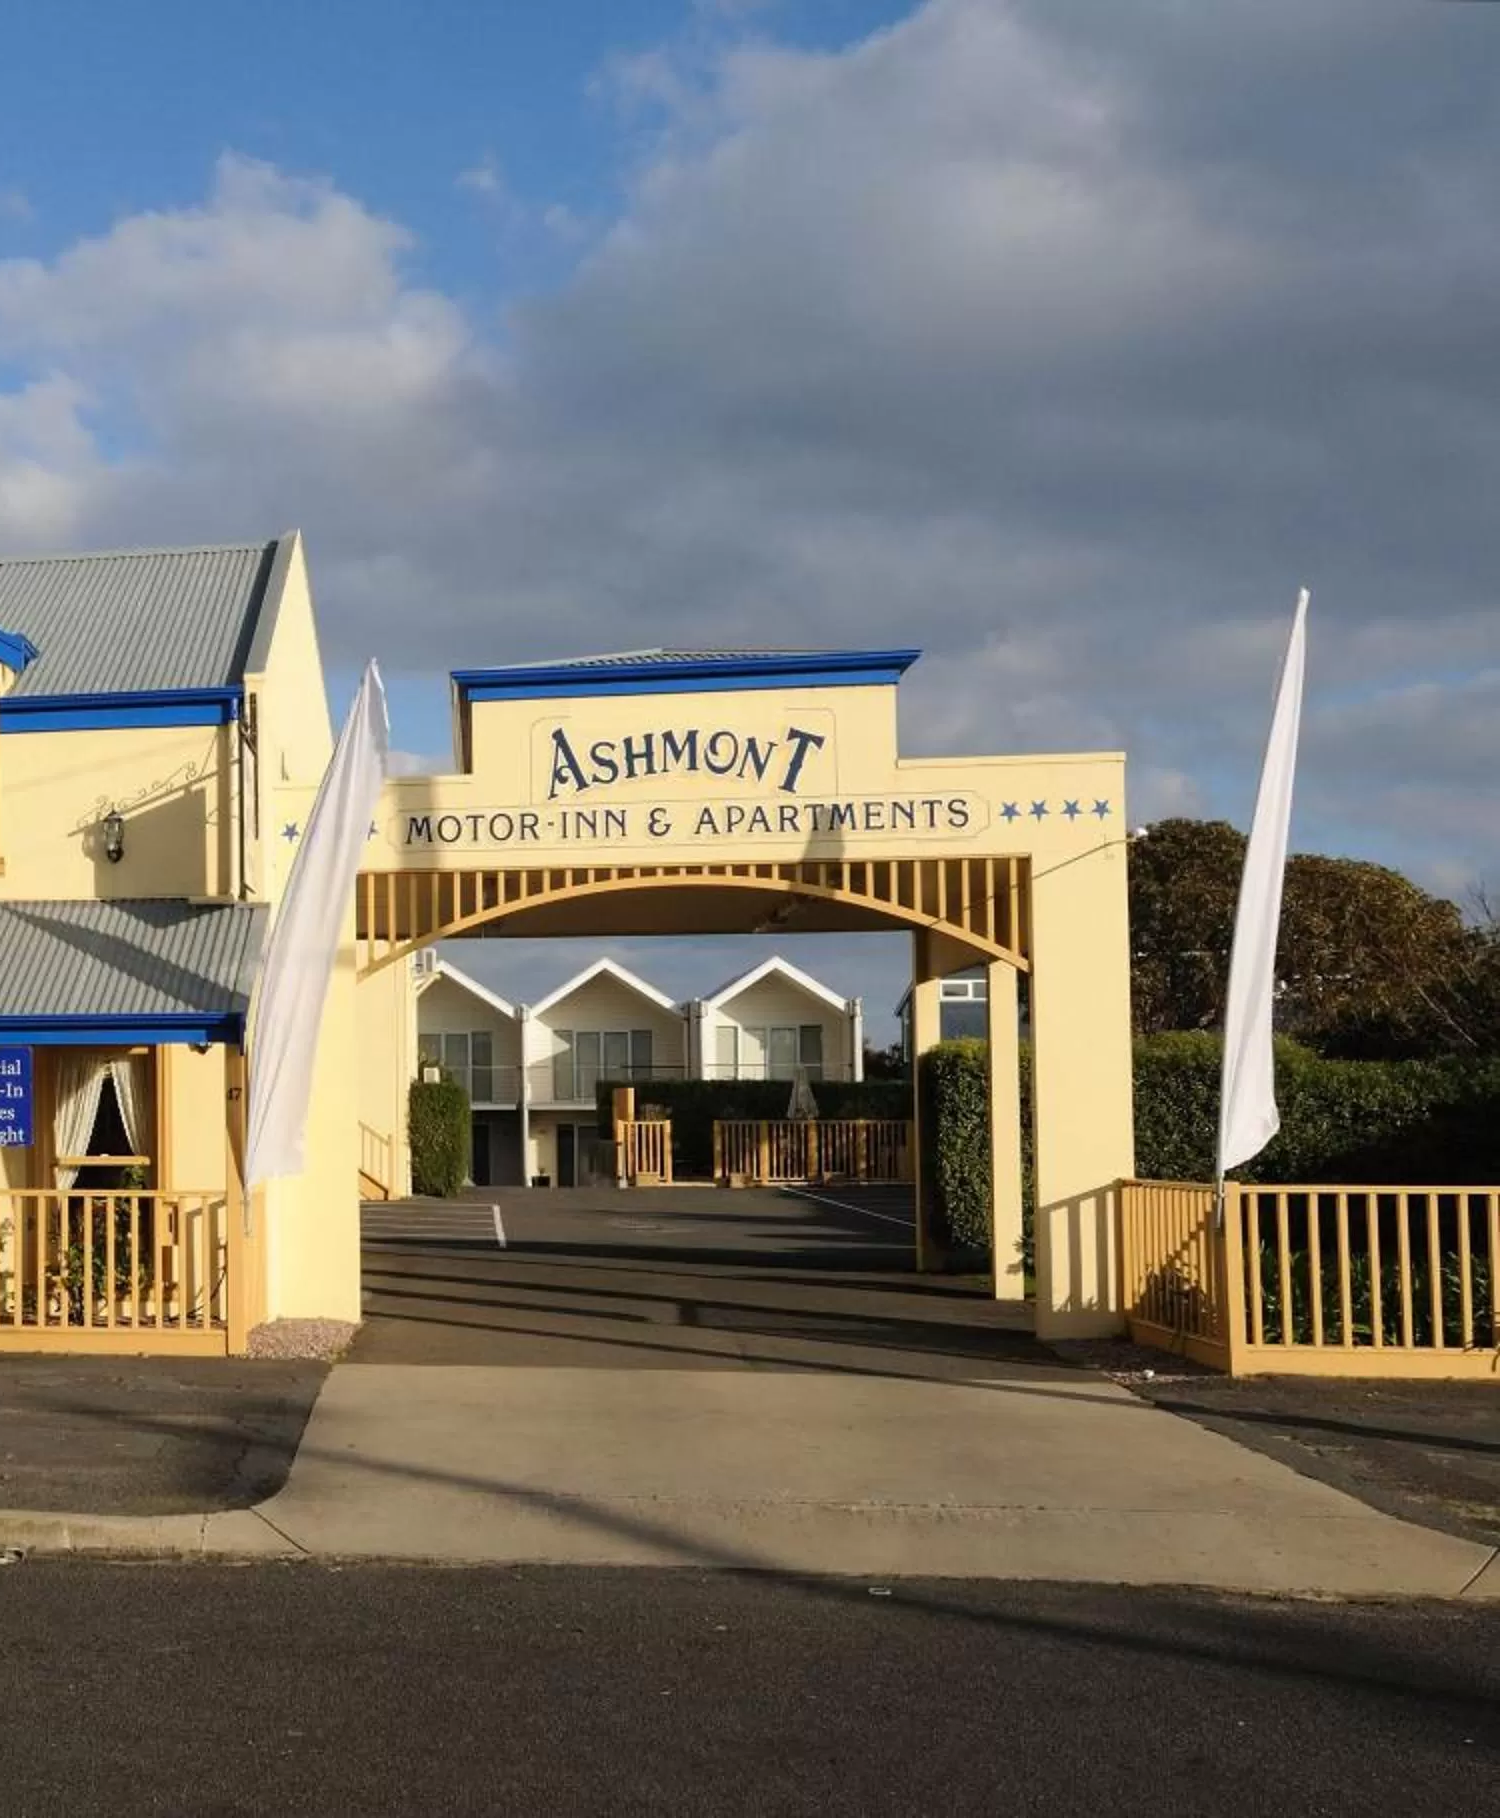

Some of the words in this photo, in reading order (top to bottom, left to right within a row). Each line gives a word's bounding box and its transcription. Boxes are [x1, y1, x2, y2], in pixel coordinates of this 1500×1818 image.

[548, 727, 826, 800] ASHMONT
[648, 808, 672, 838] &
[693, 799, 970, 837] APARTMENTS
